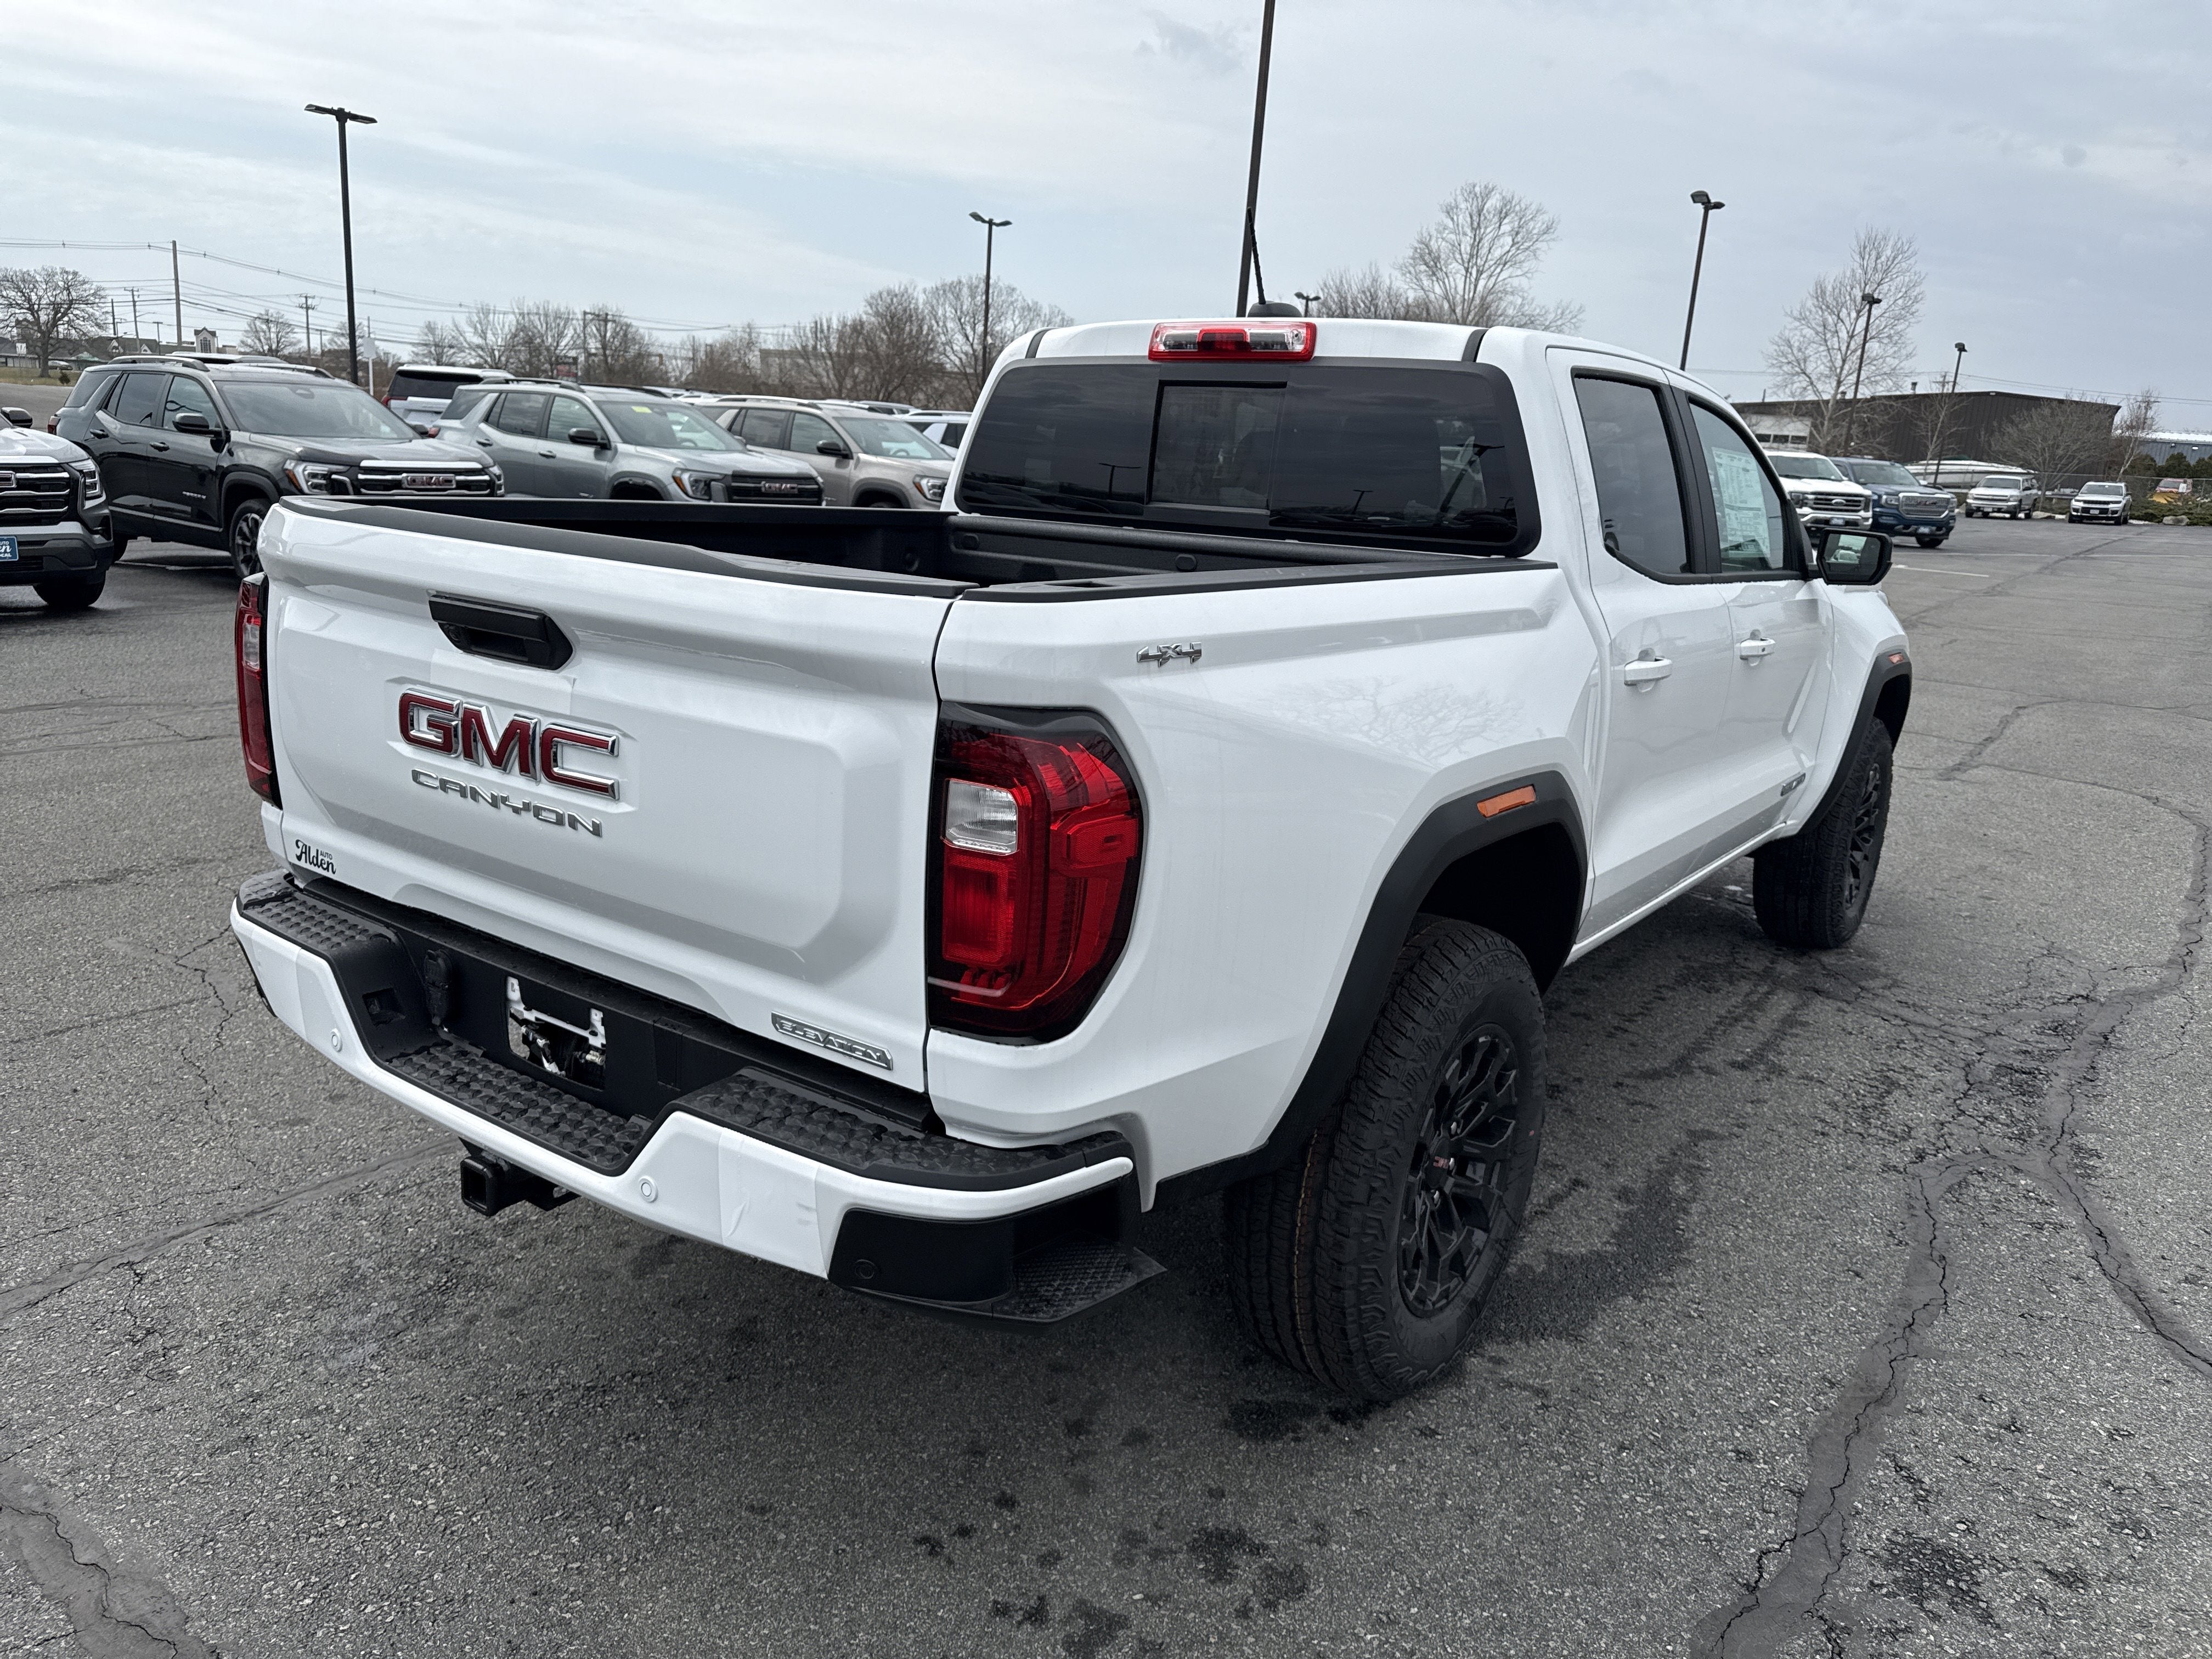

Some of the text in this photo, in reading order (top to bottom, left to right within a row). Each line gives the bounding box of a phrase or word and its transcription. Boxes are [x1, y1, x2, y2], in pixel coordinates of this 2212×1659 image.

[407, 476, 454, 486] GMC
[399, 688, 619, 800] GMC
[411, 768, 602, 837] CANYON
[295, 839, 337, 874] Alden
[320, 850, 332, 860] AUTO
[776, 1018, 882, 1063] ELEVATION
